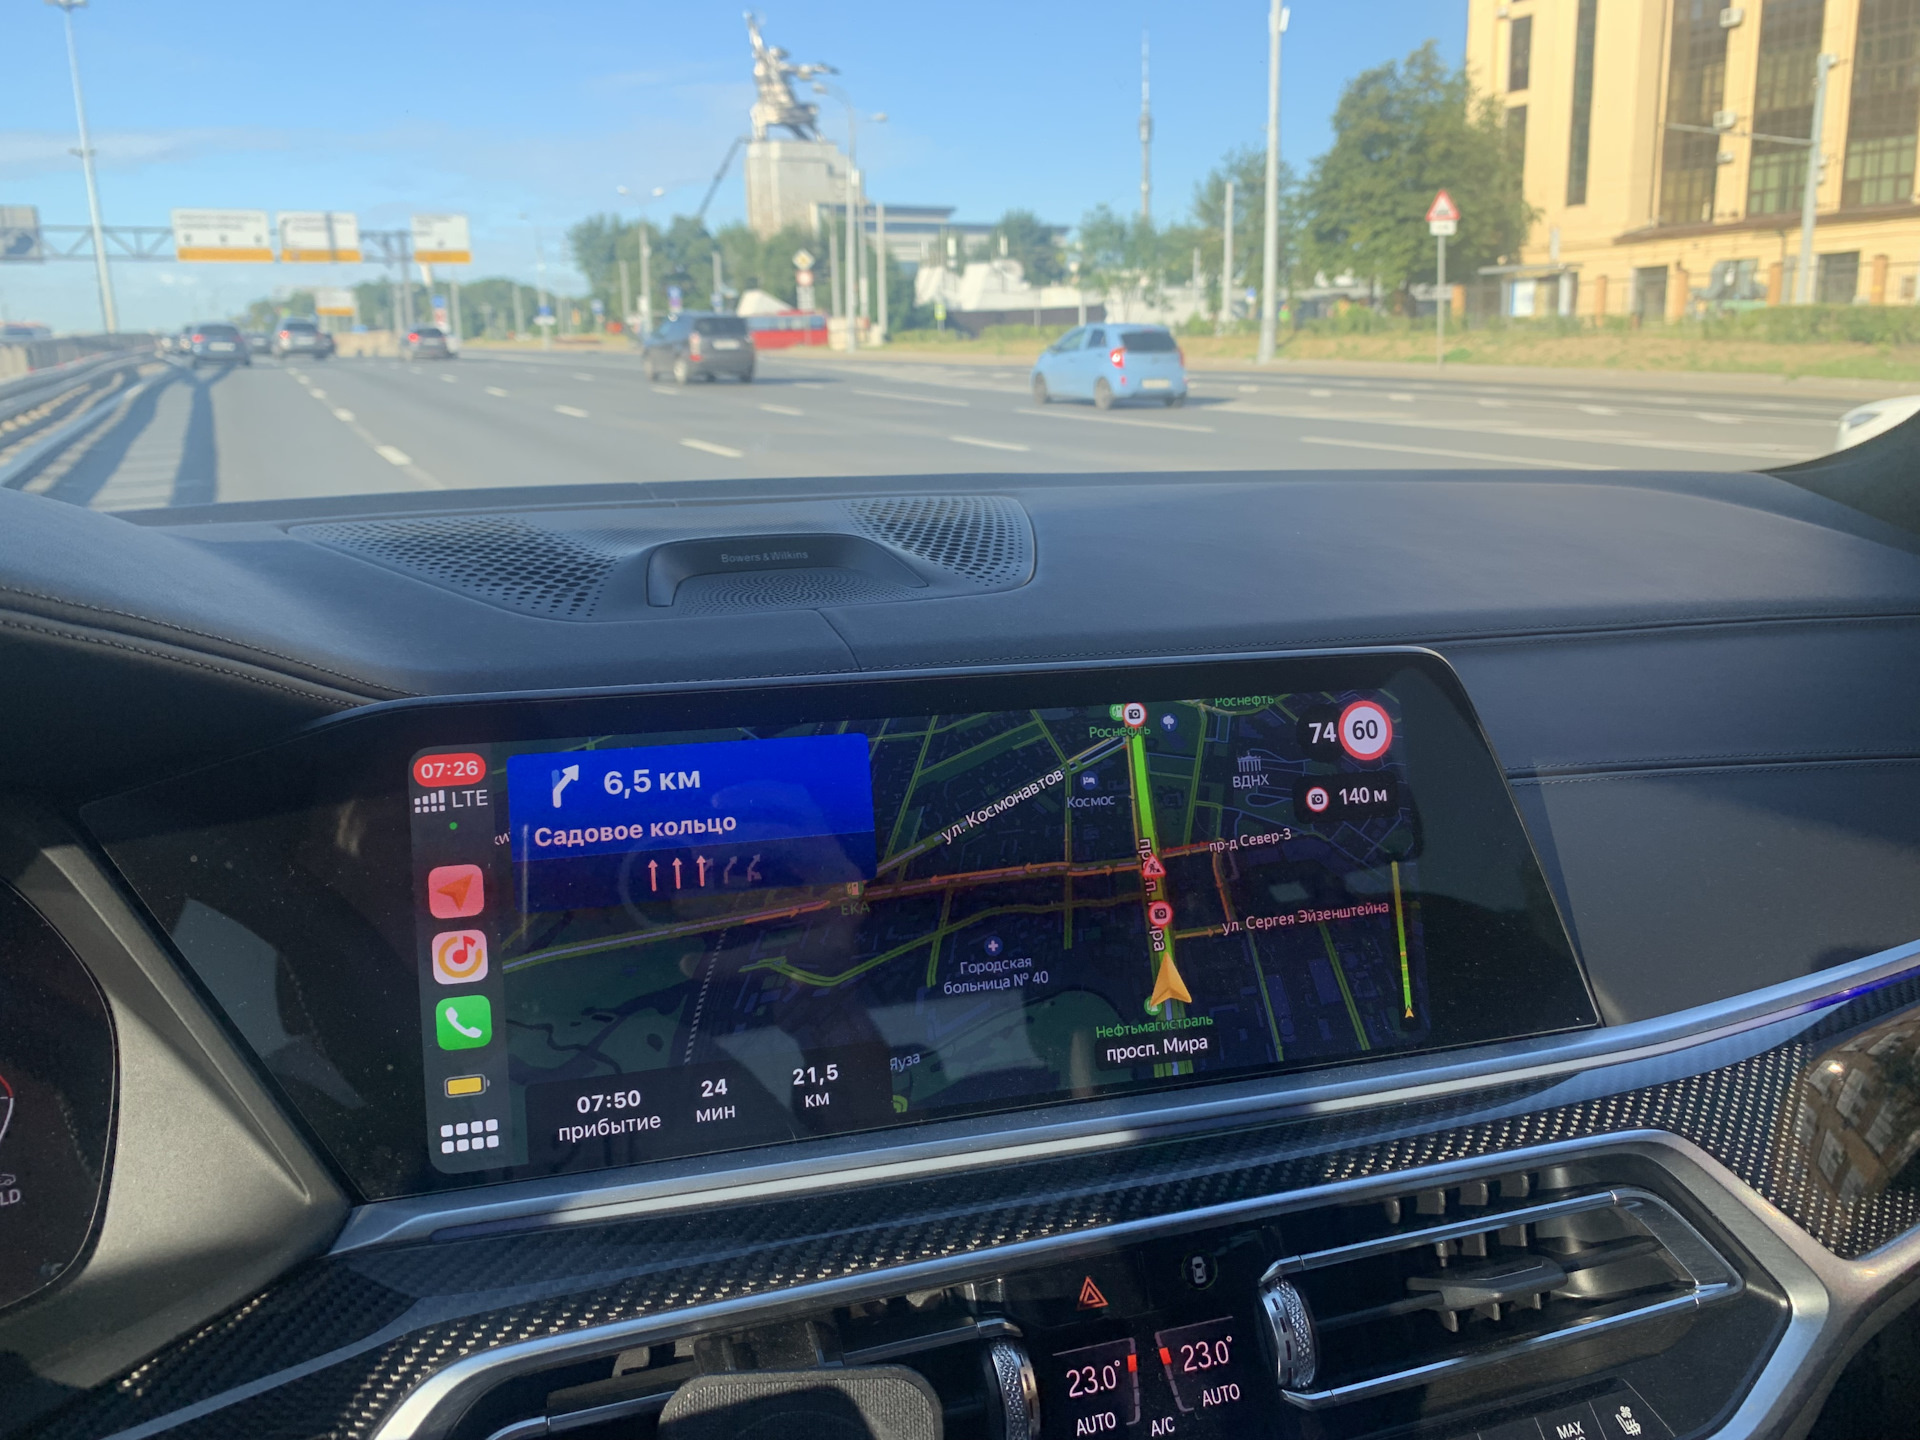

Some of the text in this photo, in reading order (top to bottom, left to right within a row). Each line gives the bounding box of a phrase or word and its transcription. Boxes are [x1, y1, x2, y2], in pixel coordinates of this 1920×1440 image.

[720, 551, 808, 563] Bowers & Wilkins
[1214, 695, 1275, 708] Роснефть
[1309, 721, 1336, 744] 74
[1352, 719, 1378, 741] 60
[420, 760, 479, 779] 07:26
[604, 769, 701, 798] 6,5 км
[1232, 772, 1270, 789] ВДНХ
[451, 788, 488, 808] LTE
[1066, 795, 1115, 808] Космос
[1339, 787, 1387, 804] 140 м
[941, 770, 1063, 844] ул. Космонавтов
[534, 825, 644, 849] Садовое
[650, 814, 738, 838] кольцо
[1208, 828, 1292, 853] пр-д Север-3
[1222, 902, 1389, 936] ул. Сергея Эйзенштейна
[959, 956, 1032, 976] Городская
[943, 978, 1009, 996] больница
[1032, 970, 1049, 985] 40
[1095, 1016, 1214, 1038] Нефтьмагистраль
[1106, 1035, 1208, 1064] просп. Мира
[889, 1053, 920, 1072] Яуза
[792, 1064, 839, 1085] 21,5
[701, 1078, 728, 1098] 24
[576, 1089, 641, 1113] 07:50
[804, 1092, 830, 1107] км
[696, 1105, 736, 1123] мин
[558, 1113, 662, 1142] прибытие
[1201, 1384, 1241, 1408] AUTO
[1076, 1412, 1117, 1437] AUTO
[1150, 1417, 1175, 1437] A/C
[1556, 1421, 1585, 1439] MAX
